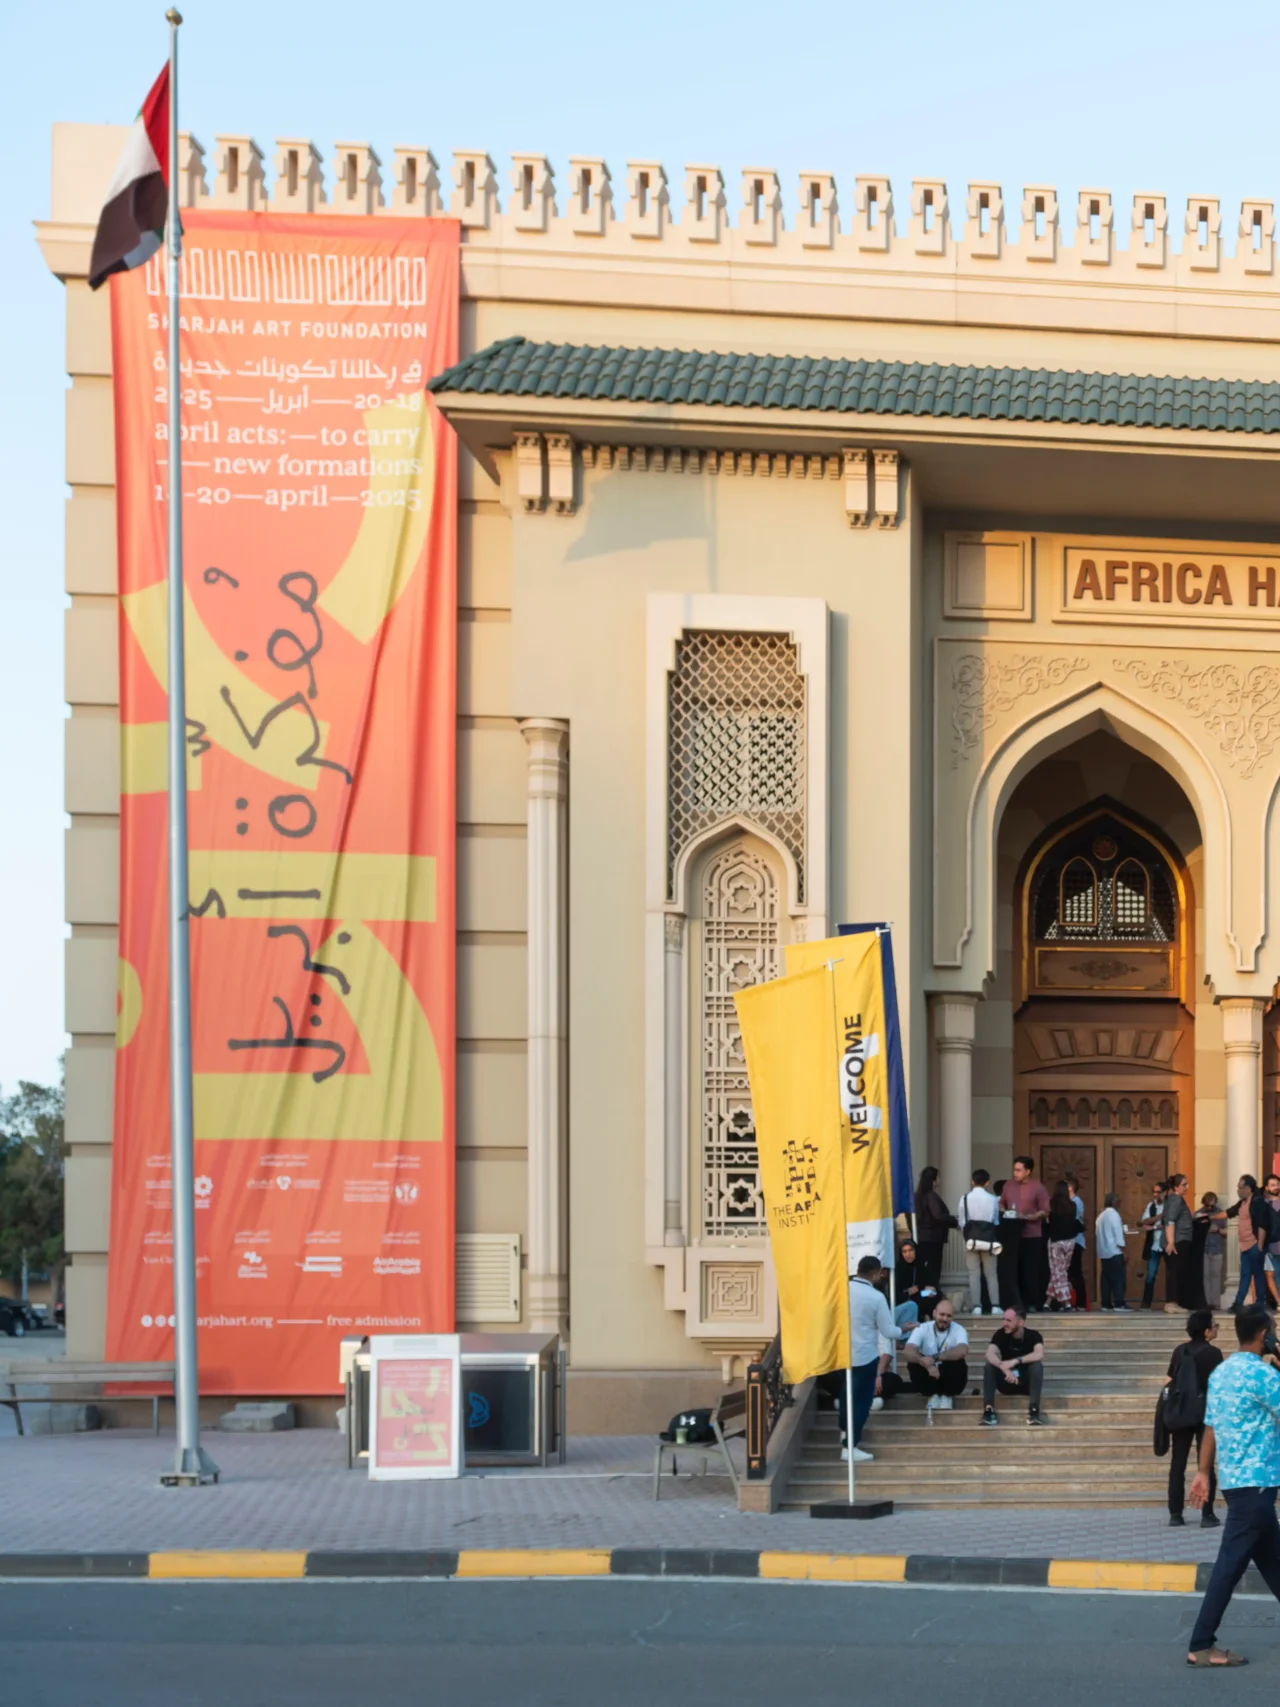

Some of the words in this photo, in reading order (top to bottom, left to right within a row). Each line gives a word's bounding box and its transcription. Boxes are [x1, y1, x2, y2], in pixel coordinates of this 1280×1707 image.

[253, 320, 291, 337] ART
[301, 321, 428, 339] FOUNDATION
[153, 350, 231, 381] جدية
[236, 356, 337, 384] تكوينات
[401, 358, 422, 384] في
[155, 387, 213, 410] 225
[262, 387, 309, 414] أبريل
[227, 424, 286, 445] acts:
[320, 425, 347, 447] to
[353, 427, 421, 450] carry
[214, 456, 271, 475] new
[277, 454, 422, 477] formations
[264, 485, 329, 511] april
[360, 490, 422, 513] 2025
[1073, 557, 1233, 606] AFRICA
[844, 1013, 869, 1154] WELCOME
[772, 1204, 793, 1217] THE
[196, 1314, 274, 1329] arjahart.org
[327, 1313, 352, 1327] free
[355, 1314, 421, 1328] admission
